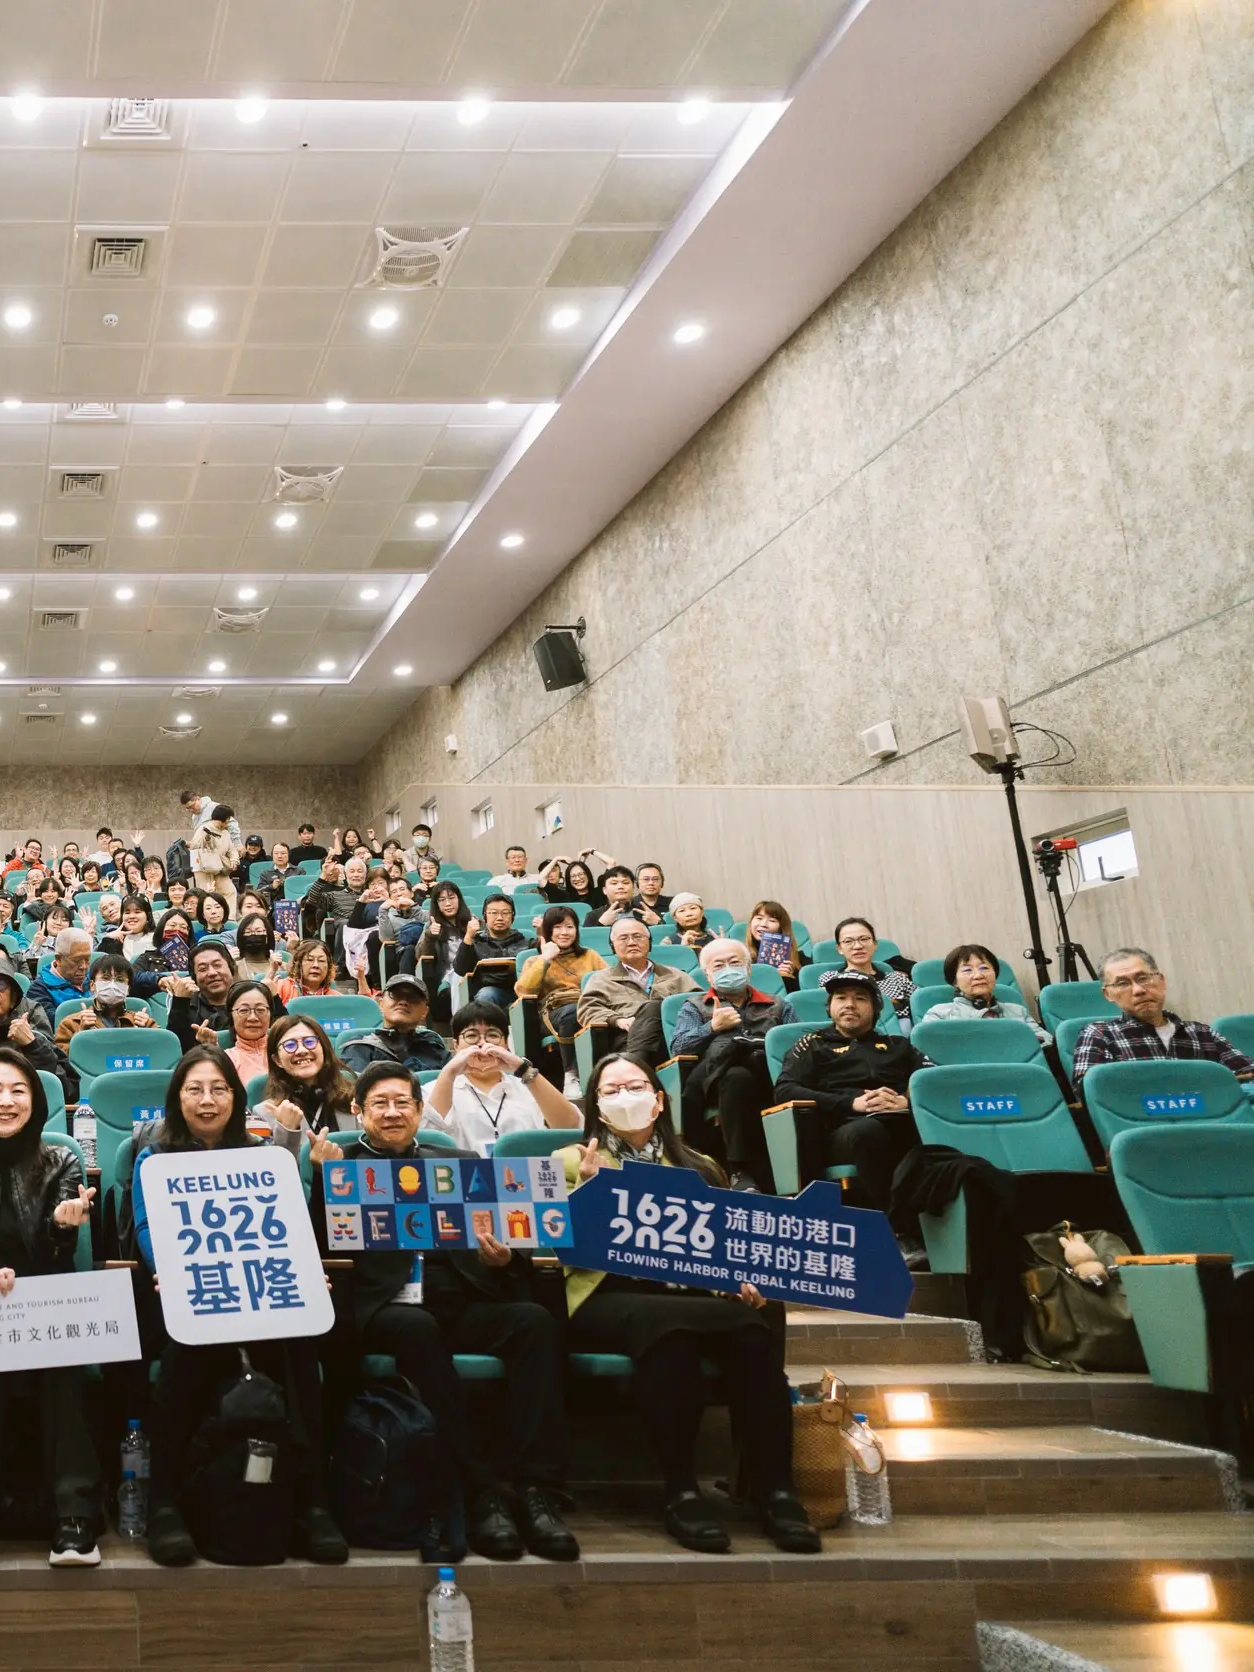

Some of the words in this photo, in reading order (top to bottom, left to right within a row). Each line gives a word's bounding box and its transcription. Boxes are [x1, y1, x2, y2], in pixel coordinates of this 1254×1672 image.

[114, 1059, 144, 1068] 保留席
[966, 1100, 1015, 1111] STAFF
[1147, 1098, 1197, 1110] STAFF
[139, 1109, 162, 1120] 黃貞
[166, 1171, 276, 1195] KEELUNG
[724, 1206, 856, 1249] 流動的港口
[724, 1238, 857, 1281] 世界的基隆
[607, 1249, 669, 1270] FLOWING
[673, 1260, 730, 1280] HARBOR
[733, 1269, 787, 1289] GLOBAL
[789, 1279, 856, 1300] KEELUNG
[184, 1256, 306, 1316] 基隆
[6, 1302, 24, 1311] AND
[27, 1299, 64, 1310] TOURISM
[67, 1296, 100, 1305] BUREAU
[7, 1313, 26, 1322] CITY
